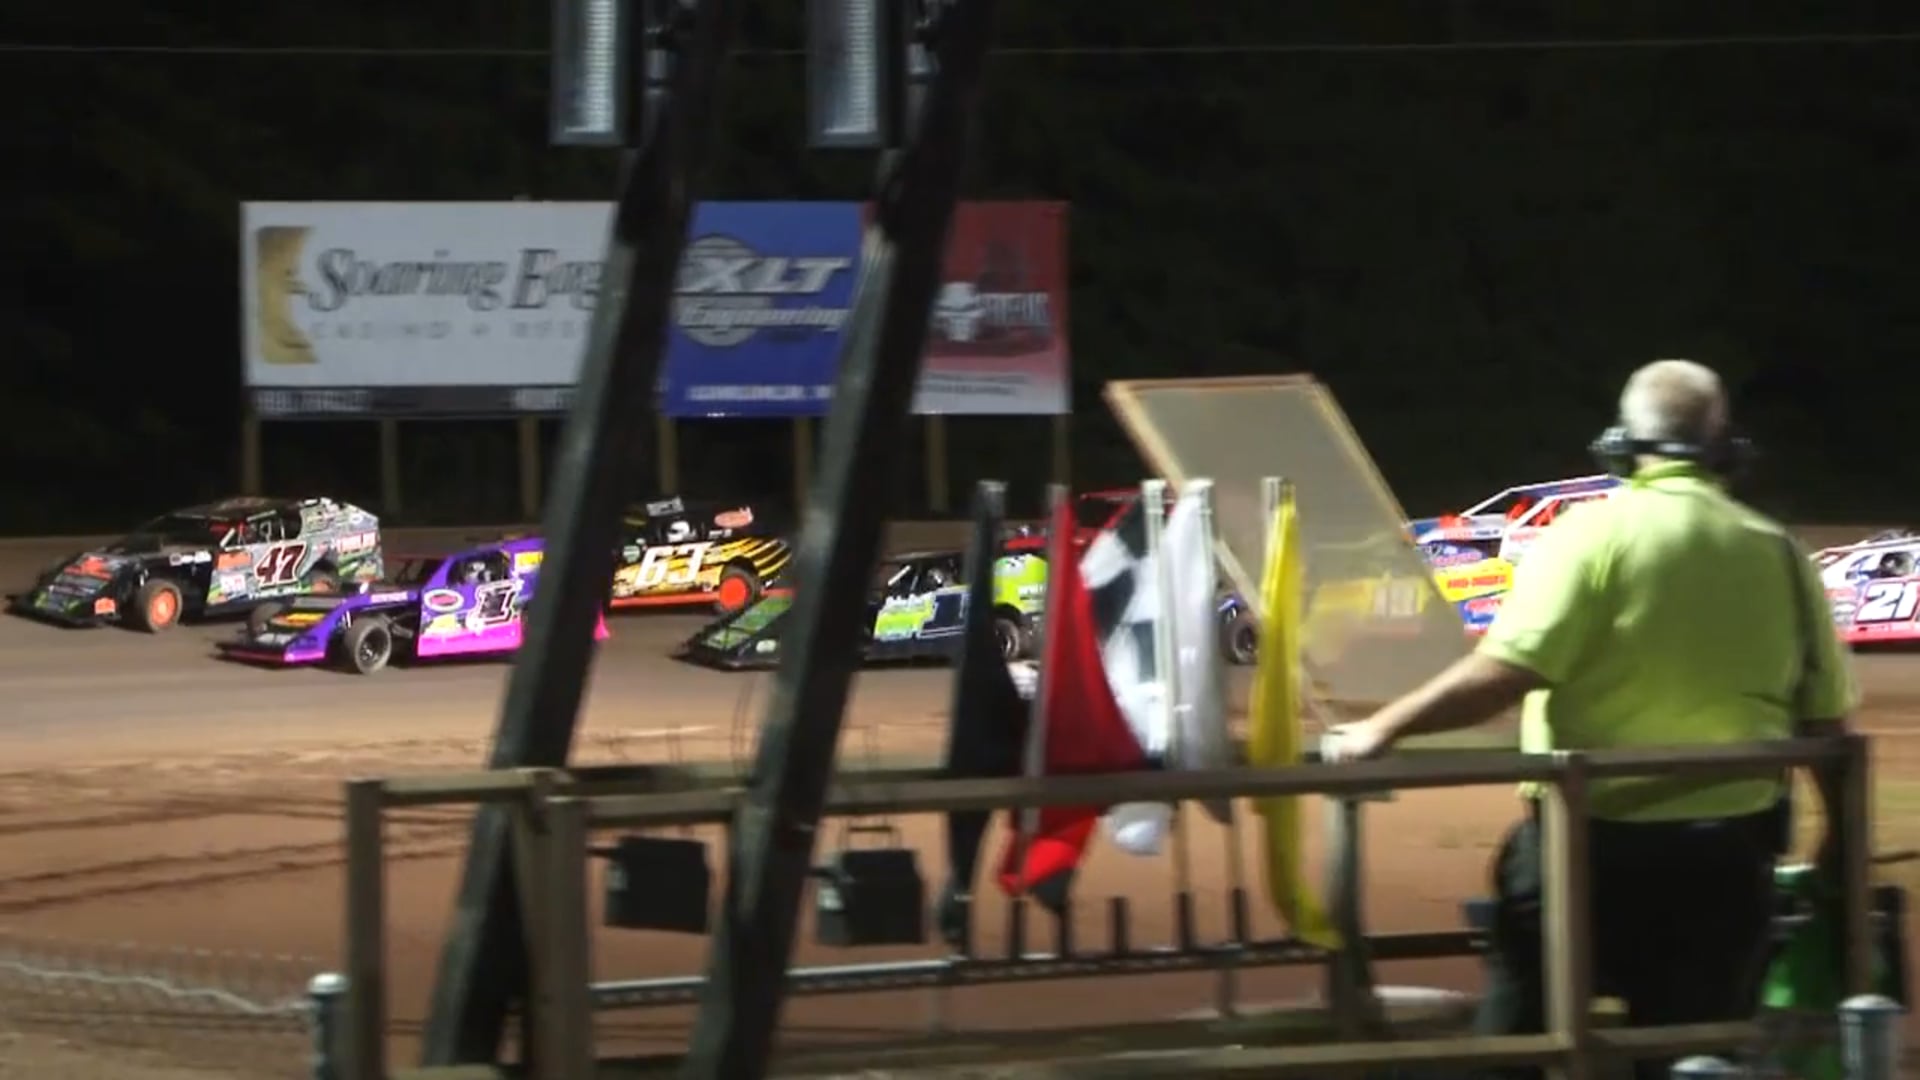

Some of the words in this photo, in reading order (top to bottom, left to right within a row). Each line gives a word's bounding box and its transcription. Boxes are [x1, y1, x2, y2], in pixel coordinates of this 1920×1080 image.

[307, 248, 508, 311] Soaring
[510, 248, 604, 311] Eag
[672, 256, 853, 293] XLT
[676, 305, 850, 333] Engineering
[254, 542, 307, 588] 47
[634, 541, 714, 588] 63
